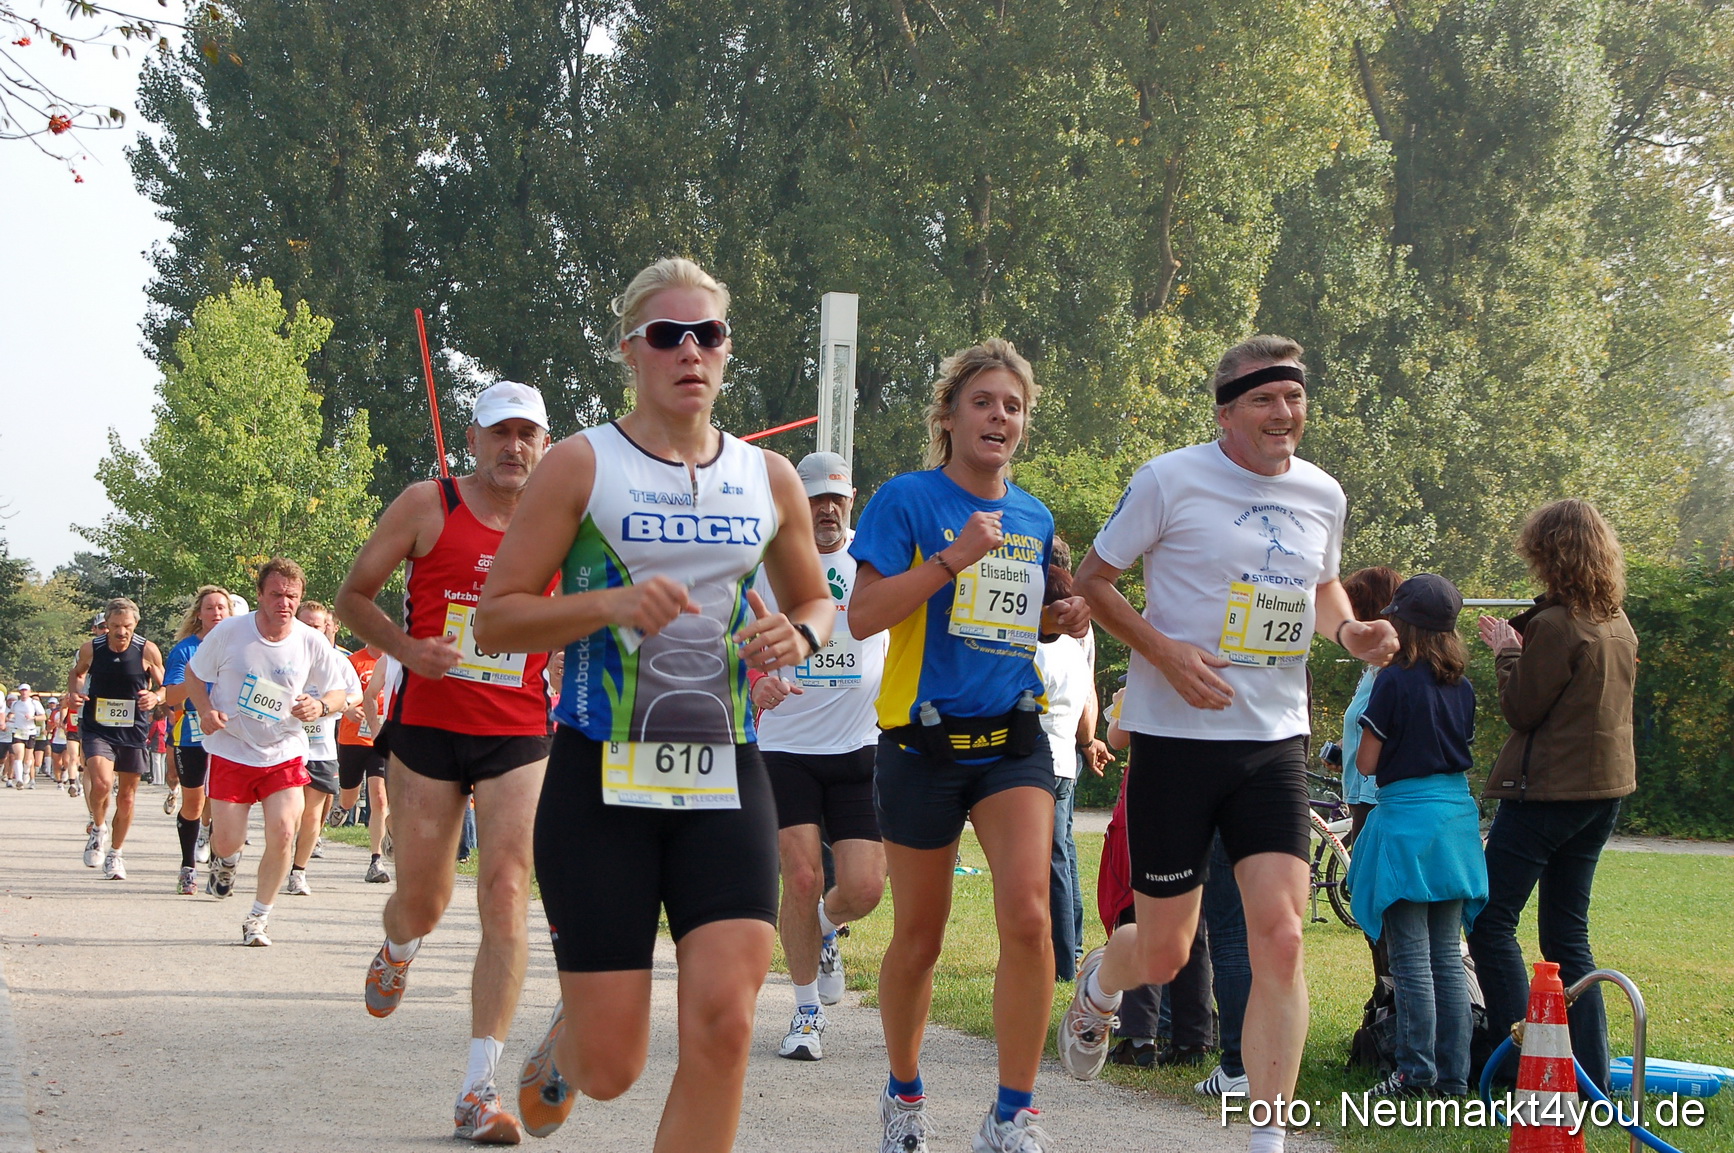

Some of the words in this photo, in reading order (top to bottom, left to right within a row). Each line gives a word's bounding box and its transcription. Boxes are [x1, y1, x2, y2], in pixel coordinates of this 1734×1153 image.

[629, 490, 692, 506] TEAM
[1233, 510, 1251, 527] Ergo
[1251, 504, 1288, 515] Runners
[1288, 510, 1305, 533] Team
[621, 512, 762, 546] BOCK
[981, 562, 1030, 584] Elisabeth
[1252, 574, 1305, 587] STAEDTLER
[444, 589, 481, 602] Katzba
[988, 589, 1029, 616] 759
[1256, 592, 1306, 614] Helmuth
[1229, 612, 1237, 625] B
[1263, 619, 1303, 643] 128
[814, 653, 856, 669] 3543
[253, 693, 283, 712] 6003
[110, 708, 129, 718] 820
[655, 743, 714, 776] 610
